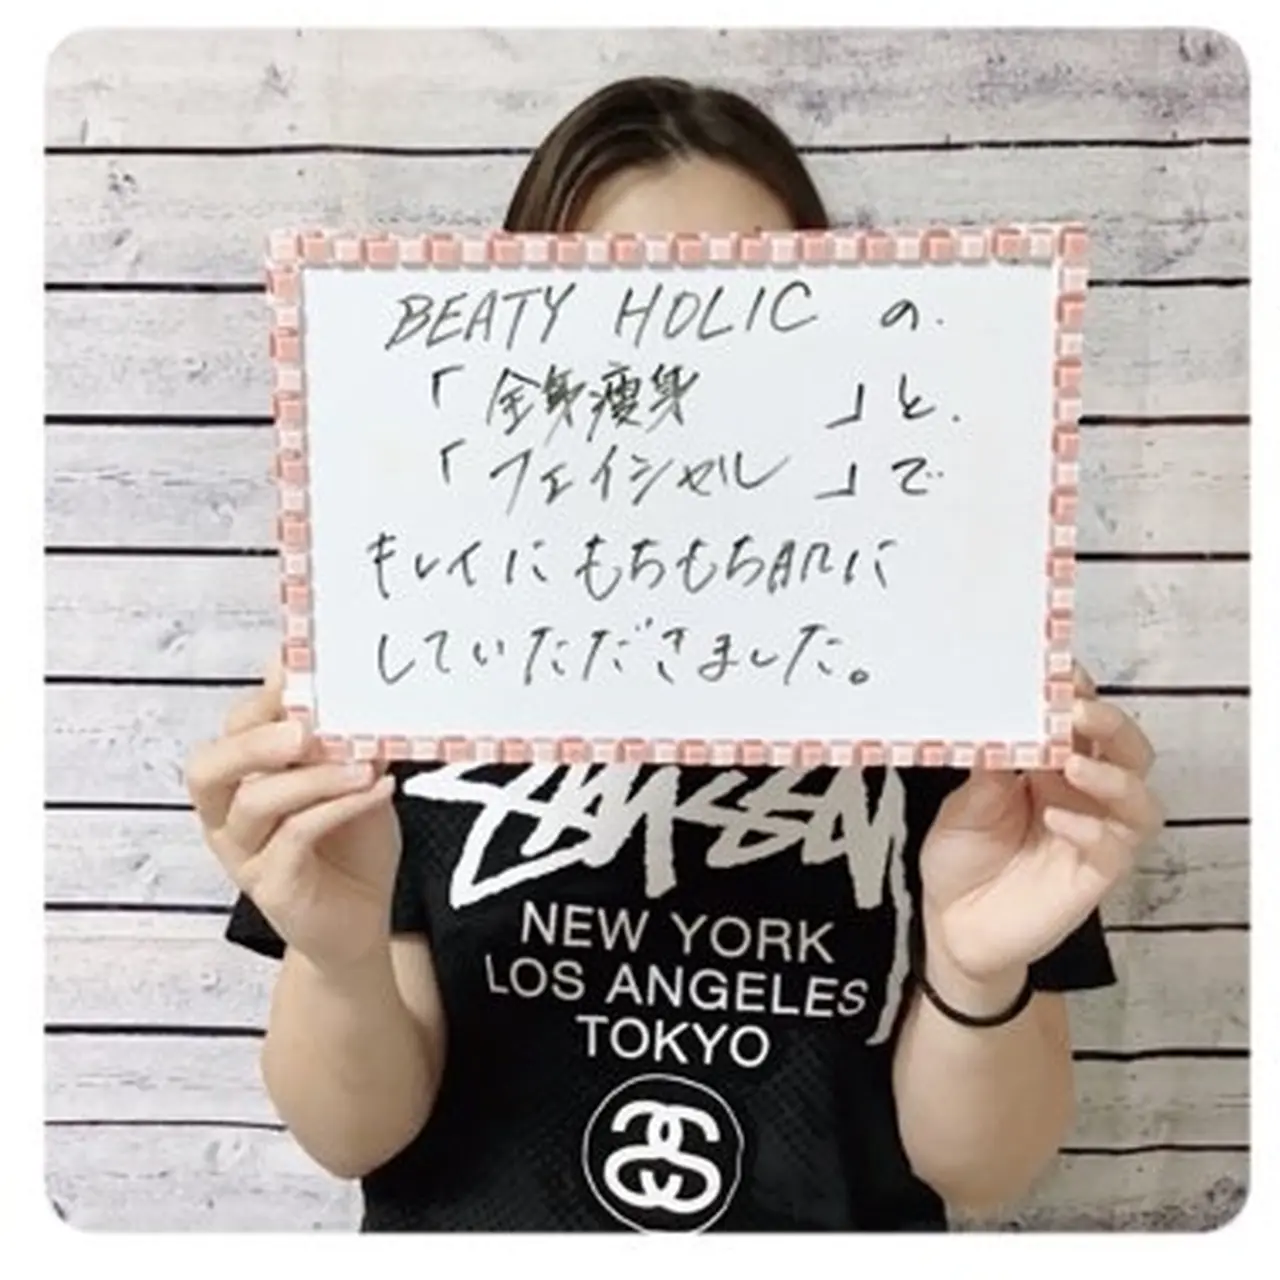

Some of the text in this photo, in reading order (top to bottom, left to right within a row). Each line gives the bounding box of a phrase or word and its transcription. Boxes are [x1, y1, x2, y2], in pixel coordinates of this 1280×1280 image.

[384, 282, 577, 351] BEATY
[614, 280, 816, 347] HOLIC
[521, 900, 836, 964] NEW YORK
[485, 953, 868, 1017] LOS ANGELES
[574, 1014, 771, 1070] TOKYO
